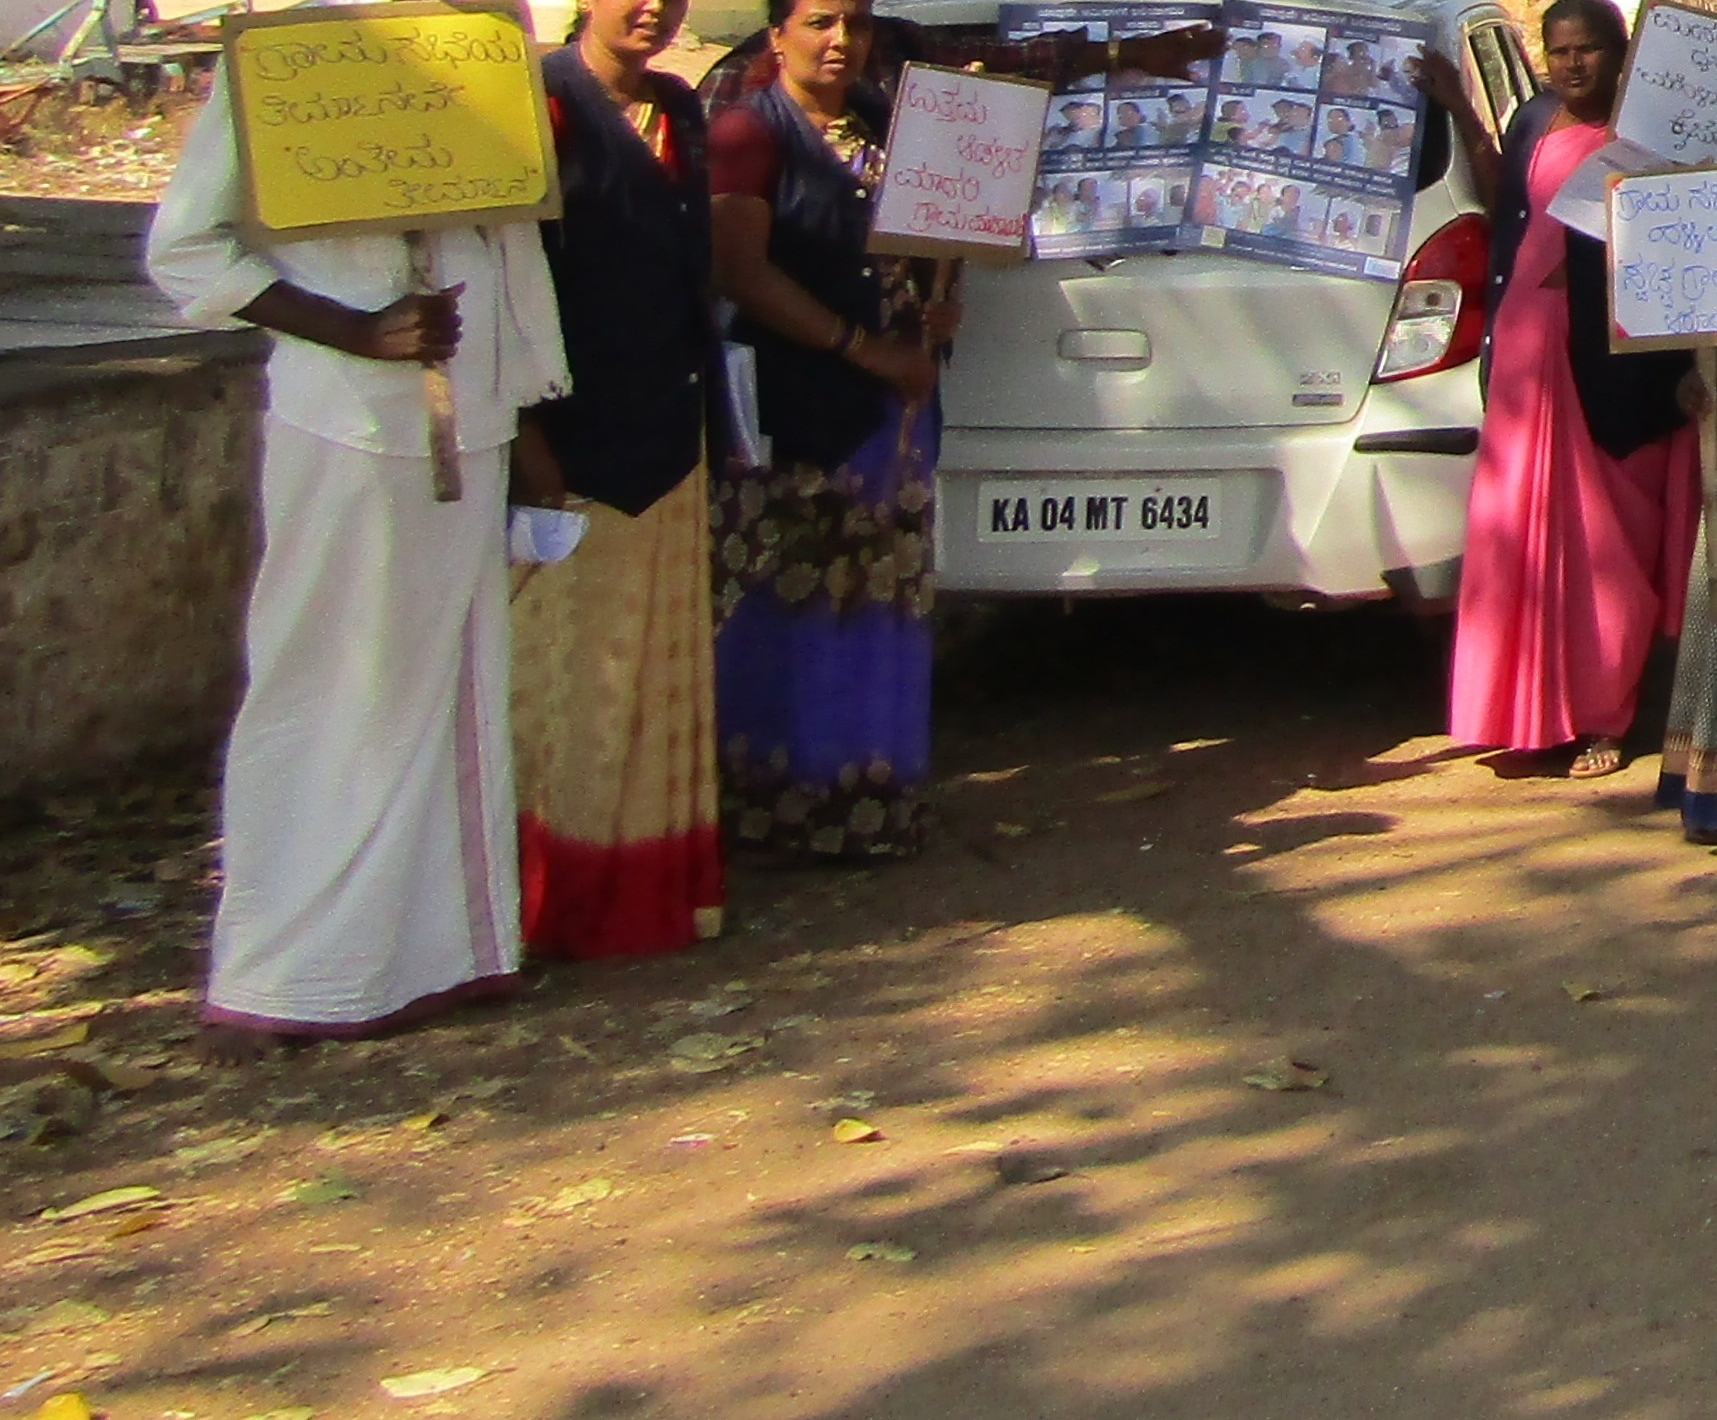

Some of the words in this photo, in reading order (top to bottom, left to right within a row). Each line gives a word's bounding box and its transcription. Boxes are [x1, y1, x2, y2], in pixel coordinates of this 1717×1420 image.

[991, 496, 1029, 532] KA
[1040, 496, 1076, 531] 04
[1085, 496, 1129, 531] MT
[1141, 495, 1209, 530] 6434
